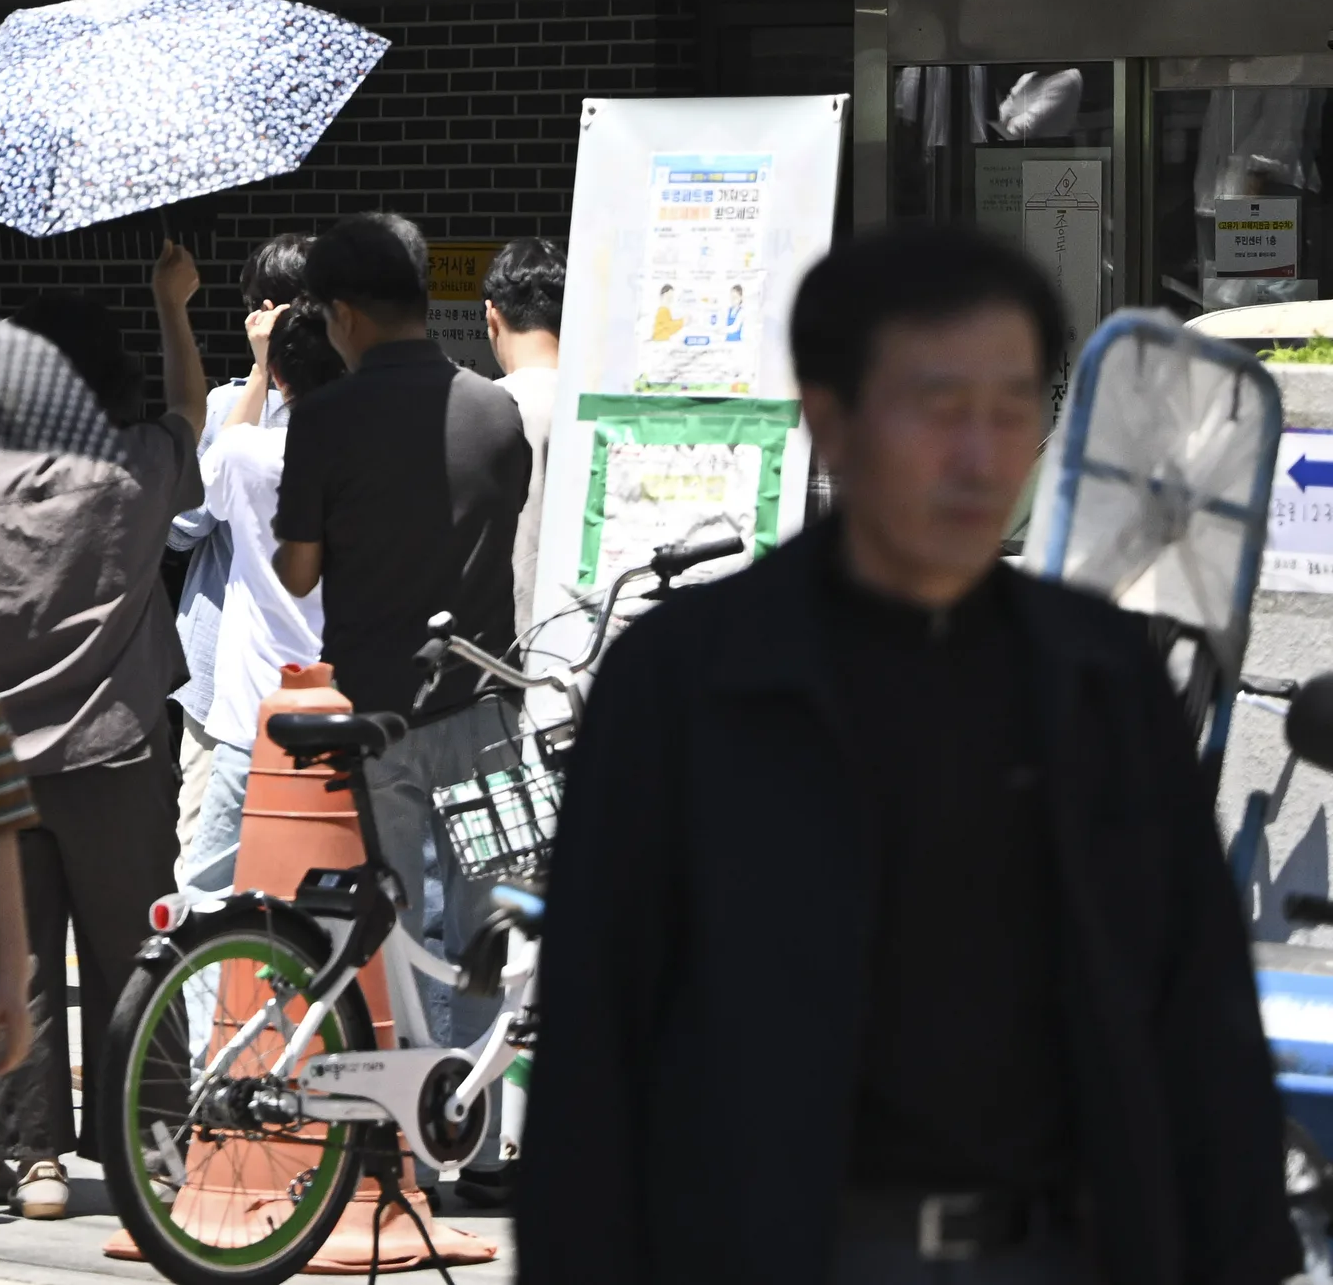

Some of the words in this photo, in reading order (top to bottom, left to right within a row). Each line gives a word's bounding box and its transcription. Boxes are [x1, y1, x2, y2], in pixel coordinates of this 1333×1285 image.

[1235, 236, 1262, 246] 주민센터
[444, 308, 459, 321] 각종
[461, 308, 477, 321] 재난
